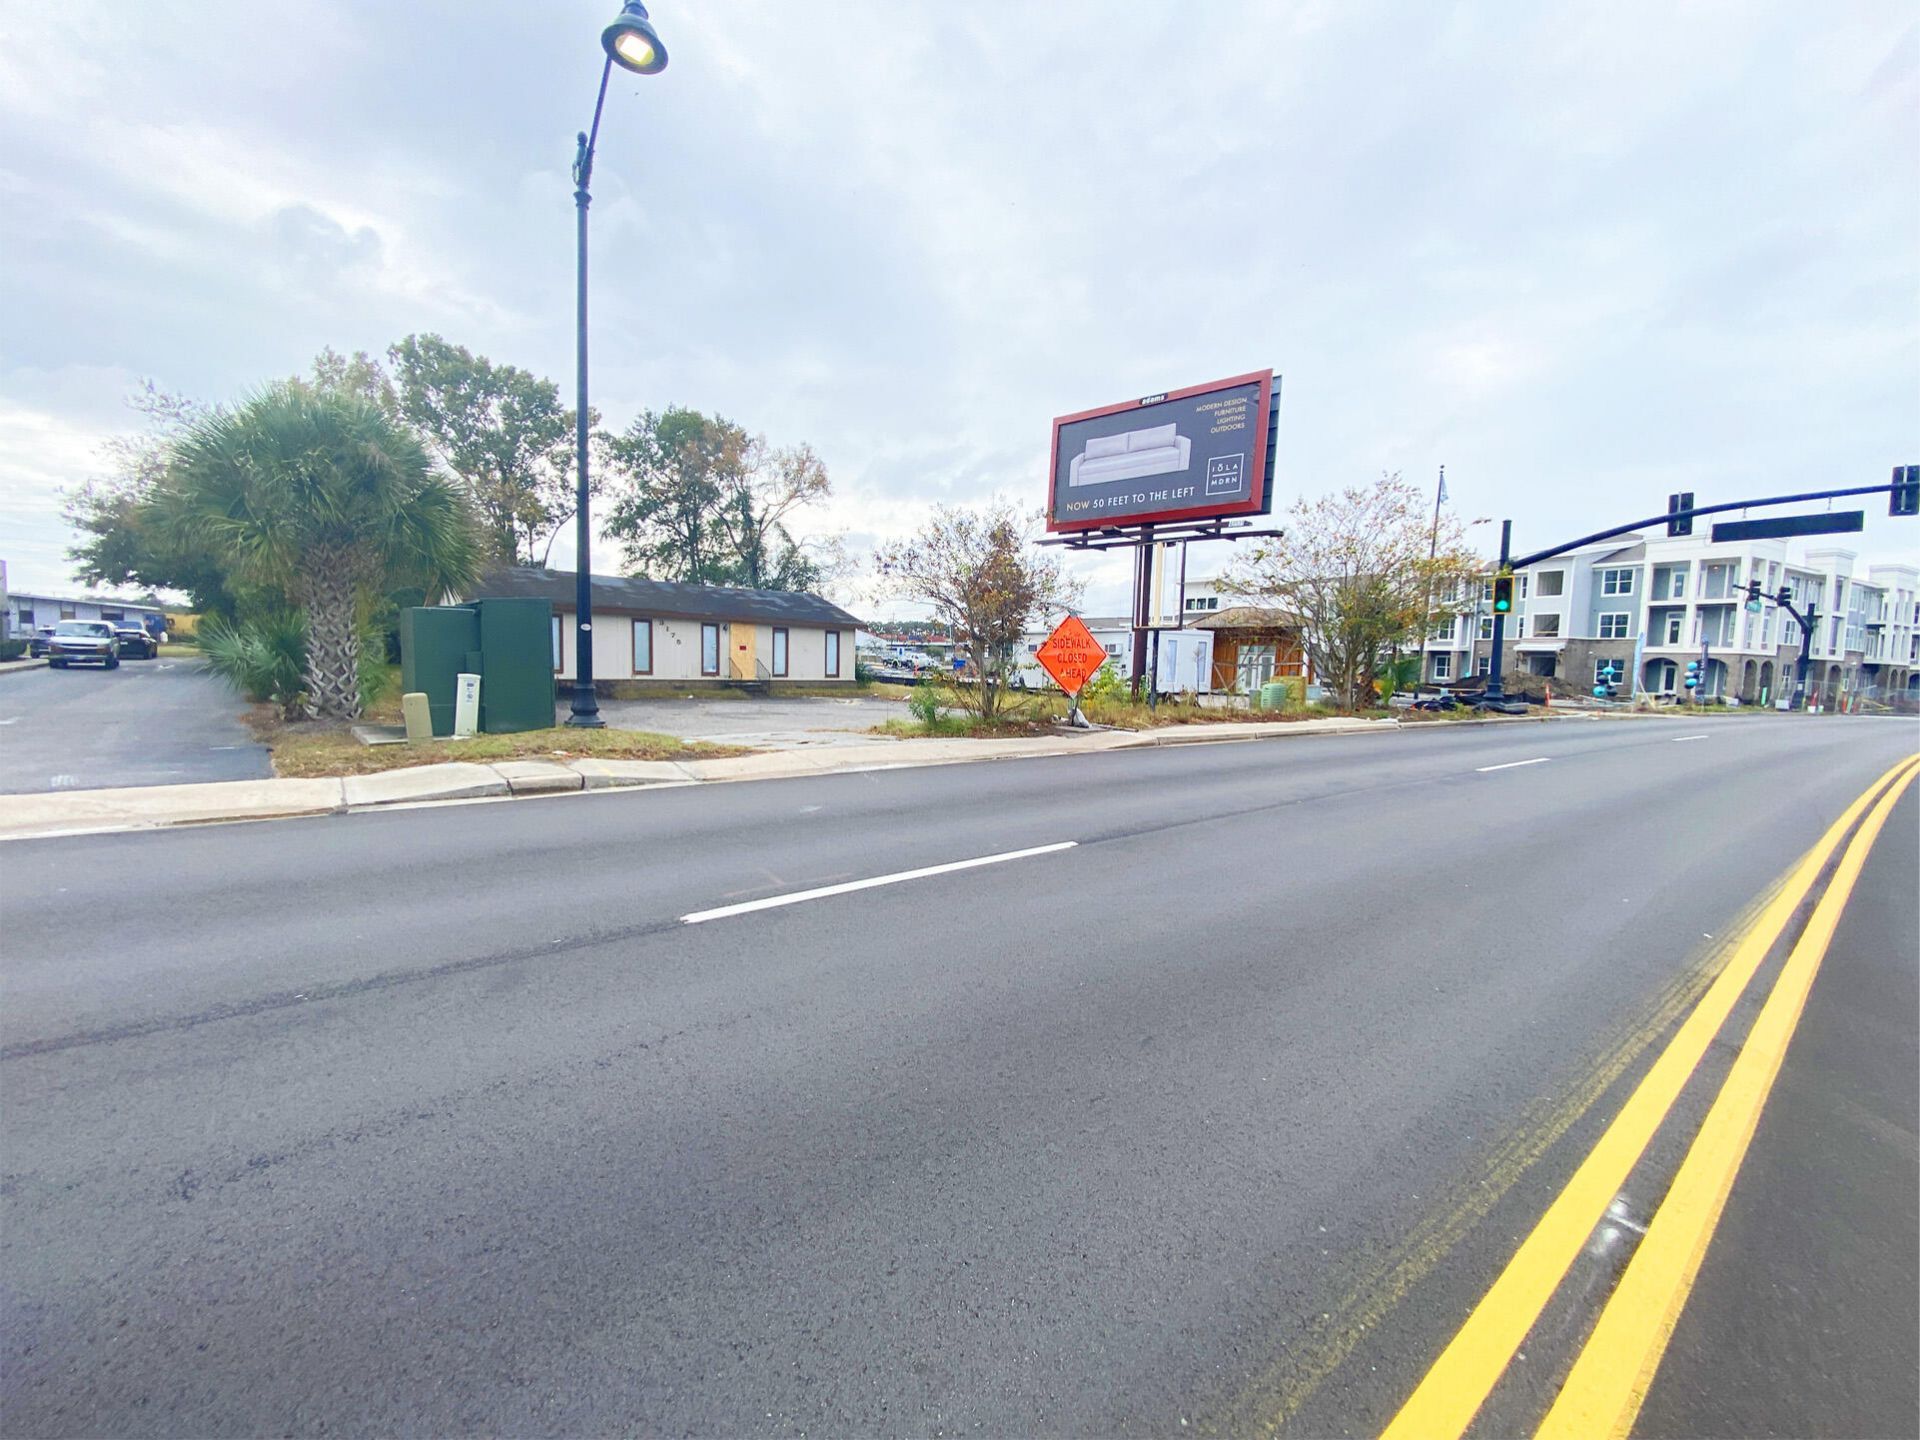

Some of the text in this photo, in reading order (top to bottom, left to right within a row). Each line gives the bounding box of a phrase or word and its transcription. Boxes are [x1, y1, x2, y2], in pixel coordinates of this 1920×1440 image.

[1196, 397, 1248, 412] MODERN DESIGN
[1214, 406, 1246, 416] FURNITURE
[1216, 414, 1246, 424] LIGHTING
[1210, 422, 1245, 433] OUTDOORS
[1066, 486, 1195, 512] NOW 50 FEET TO THE LEFT
[1053, 637, 1091, 649] SIDEWALK
[1057, 652, 1087, 664] CLOSED
[1060, 667, 1087, 679] AHEAD
